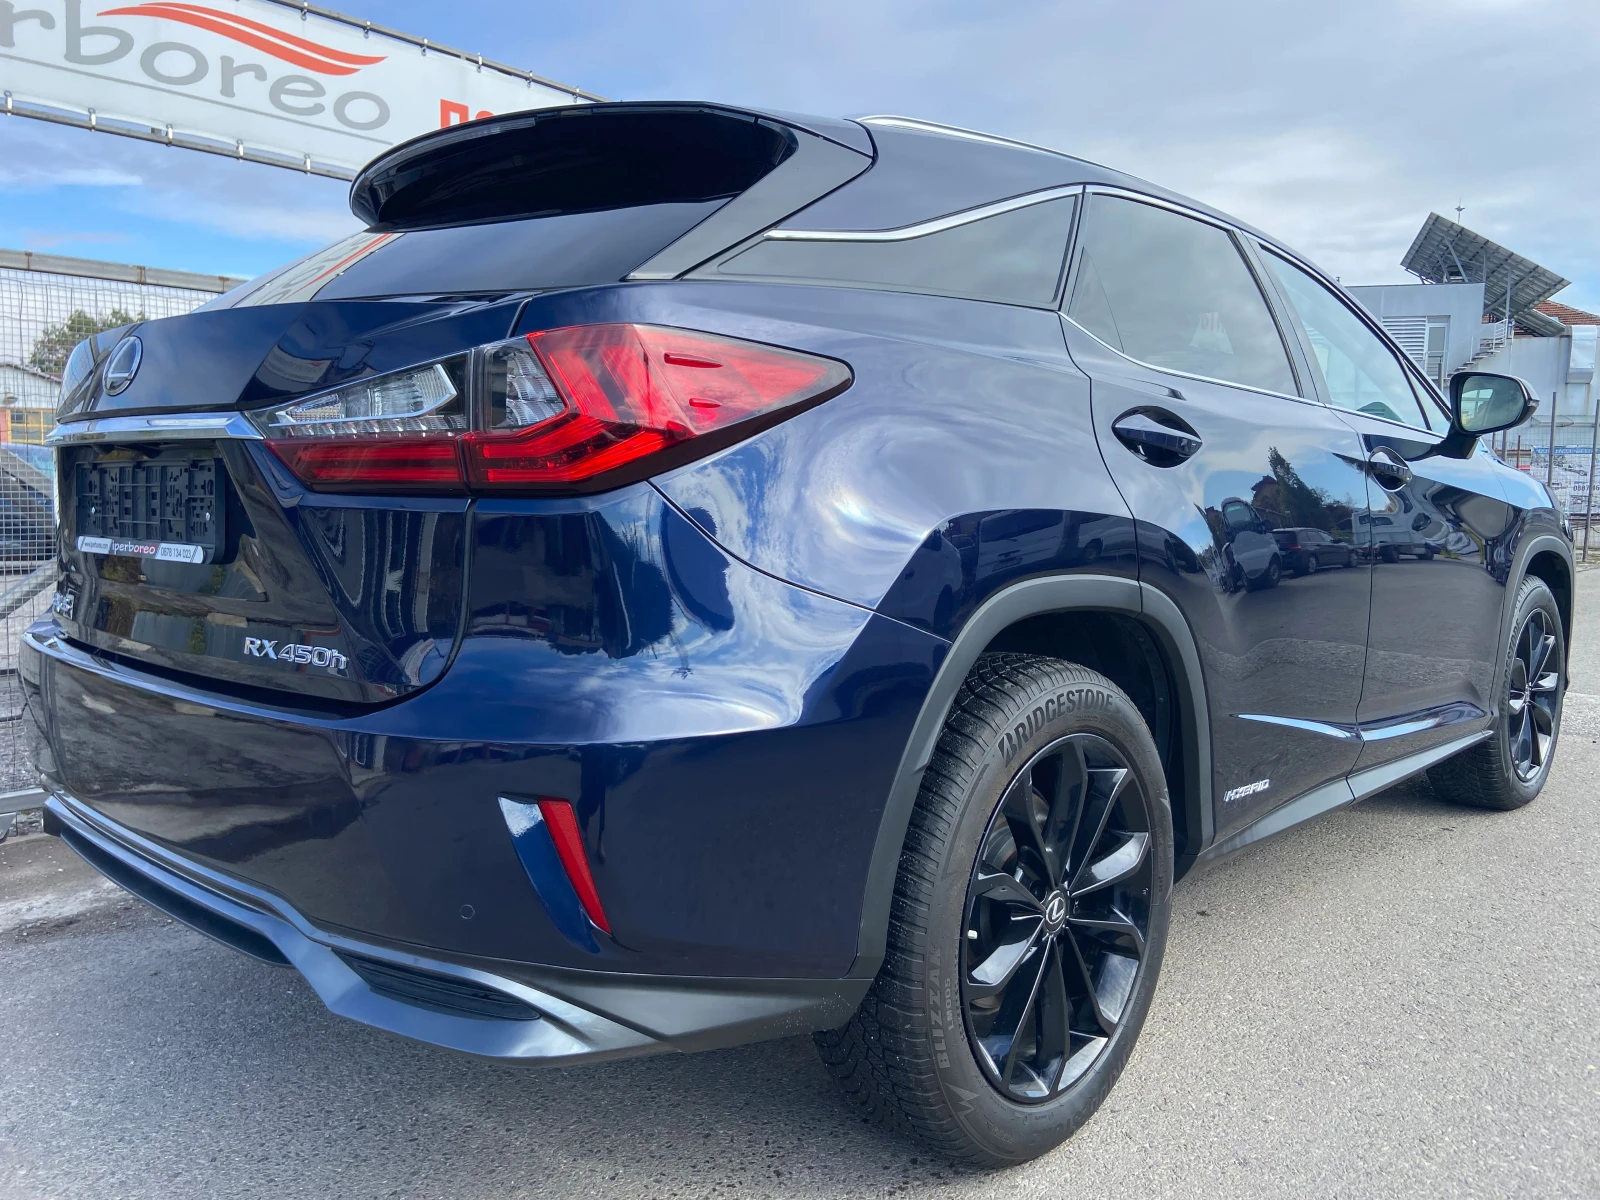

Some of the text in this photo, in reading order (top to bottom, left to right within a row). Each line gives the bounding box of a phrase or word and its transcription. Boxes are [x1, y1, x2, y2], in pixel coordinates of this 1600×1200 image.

[440, 99, 495, 129] П
[112, 540, 156, 555] iperboreo
[998, 689, 1113, 767] BRIDGESTONE
[927, 945, 950, 1069] BLIZZAK
